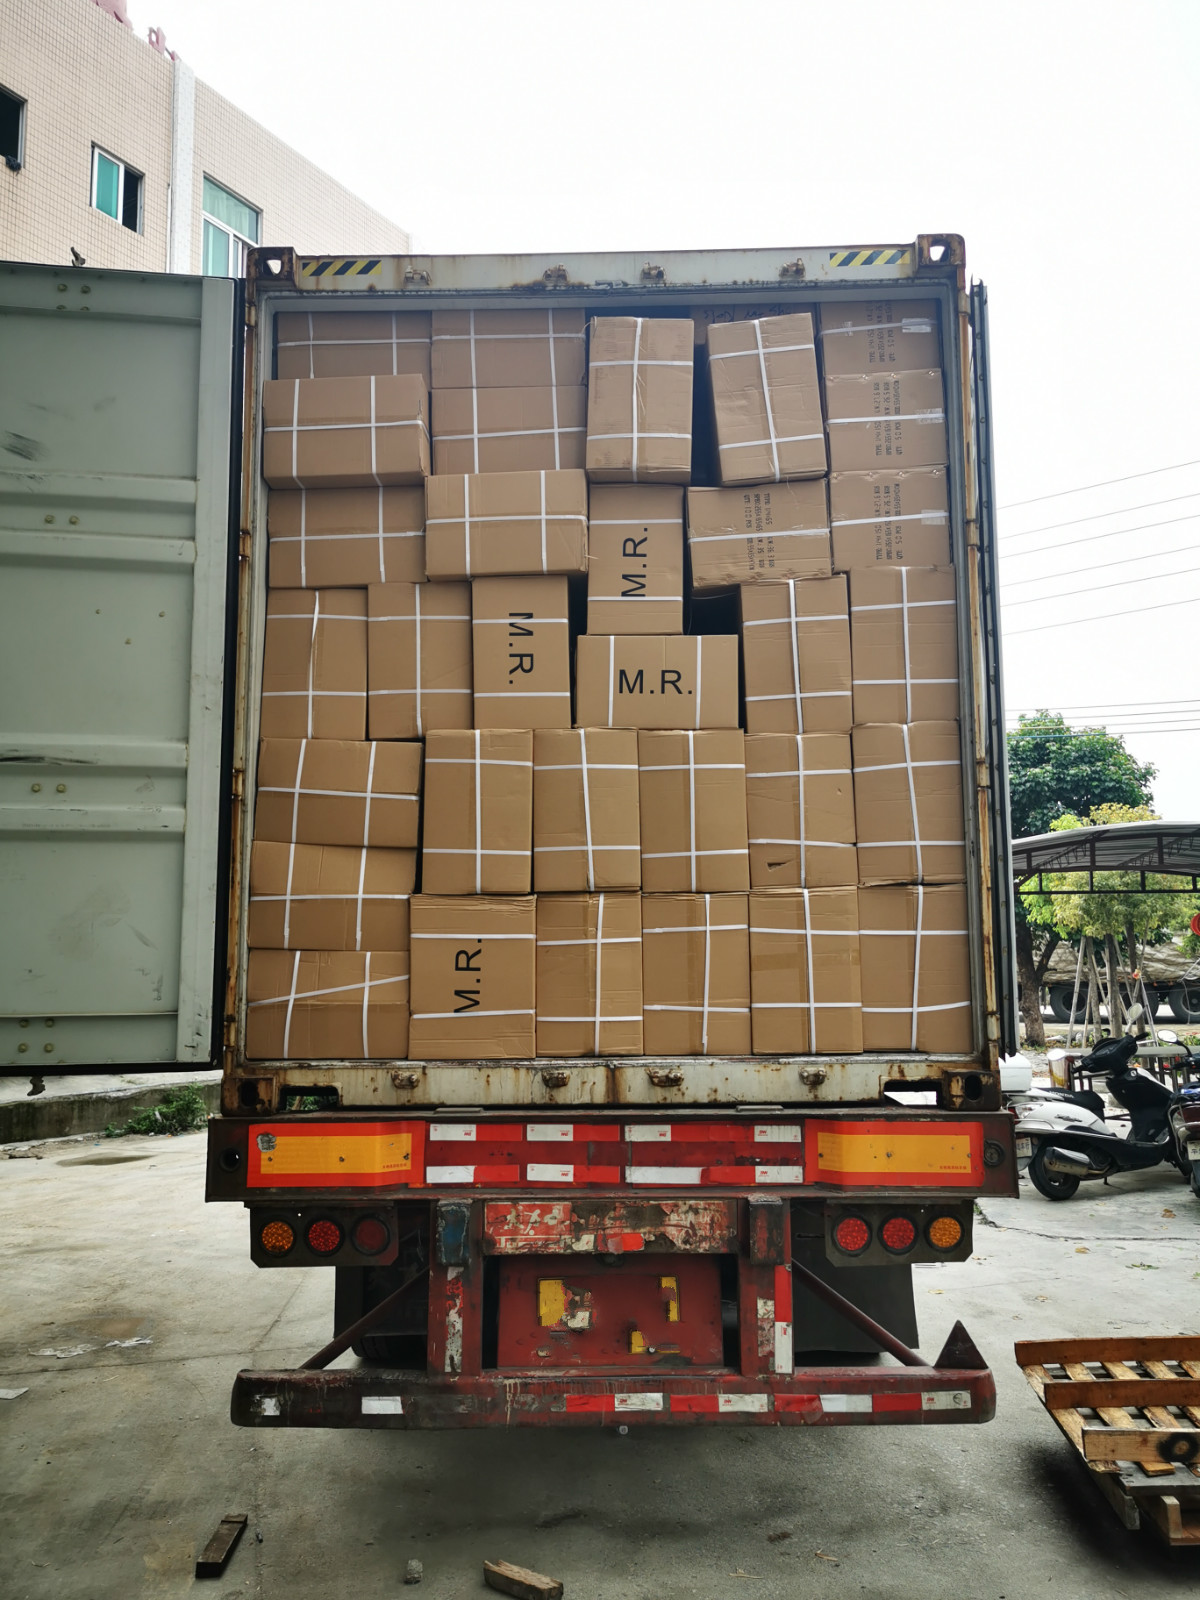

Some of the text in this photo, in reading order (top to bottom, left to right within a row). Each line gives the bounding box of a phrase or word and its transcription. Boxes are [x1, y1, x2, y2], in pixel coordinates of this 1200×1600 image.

[620, 527, 648, 598] M.R.
[508, 612, 534, 685] M.R.
[618, 669, 693, 695] M.R.
[453, 938, 482, 1013] M.R.
